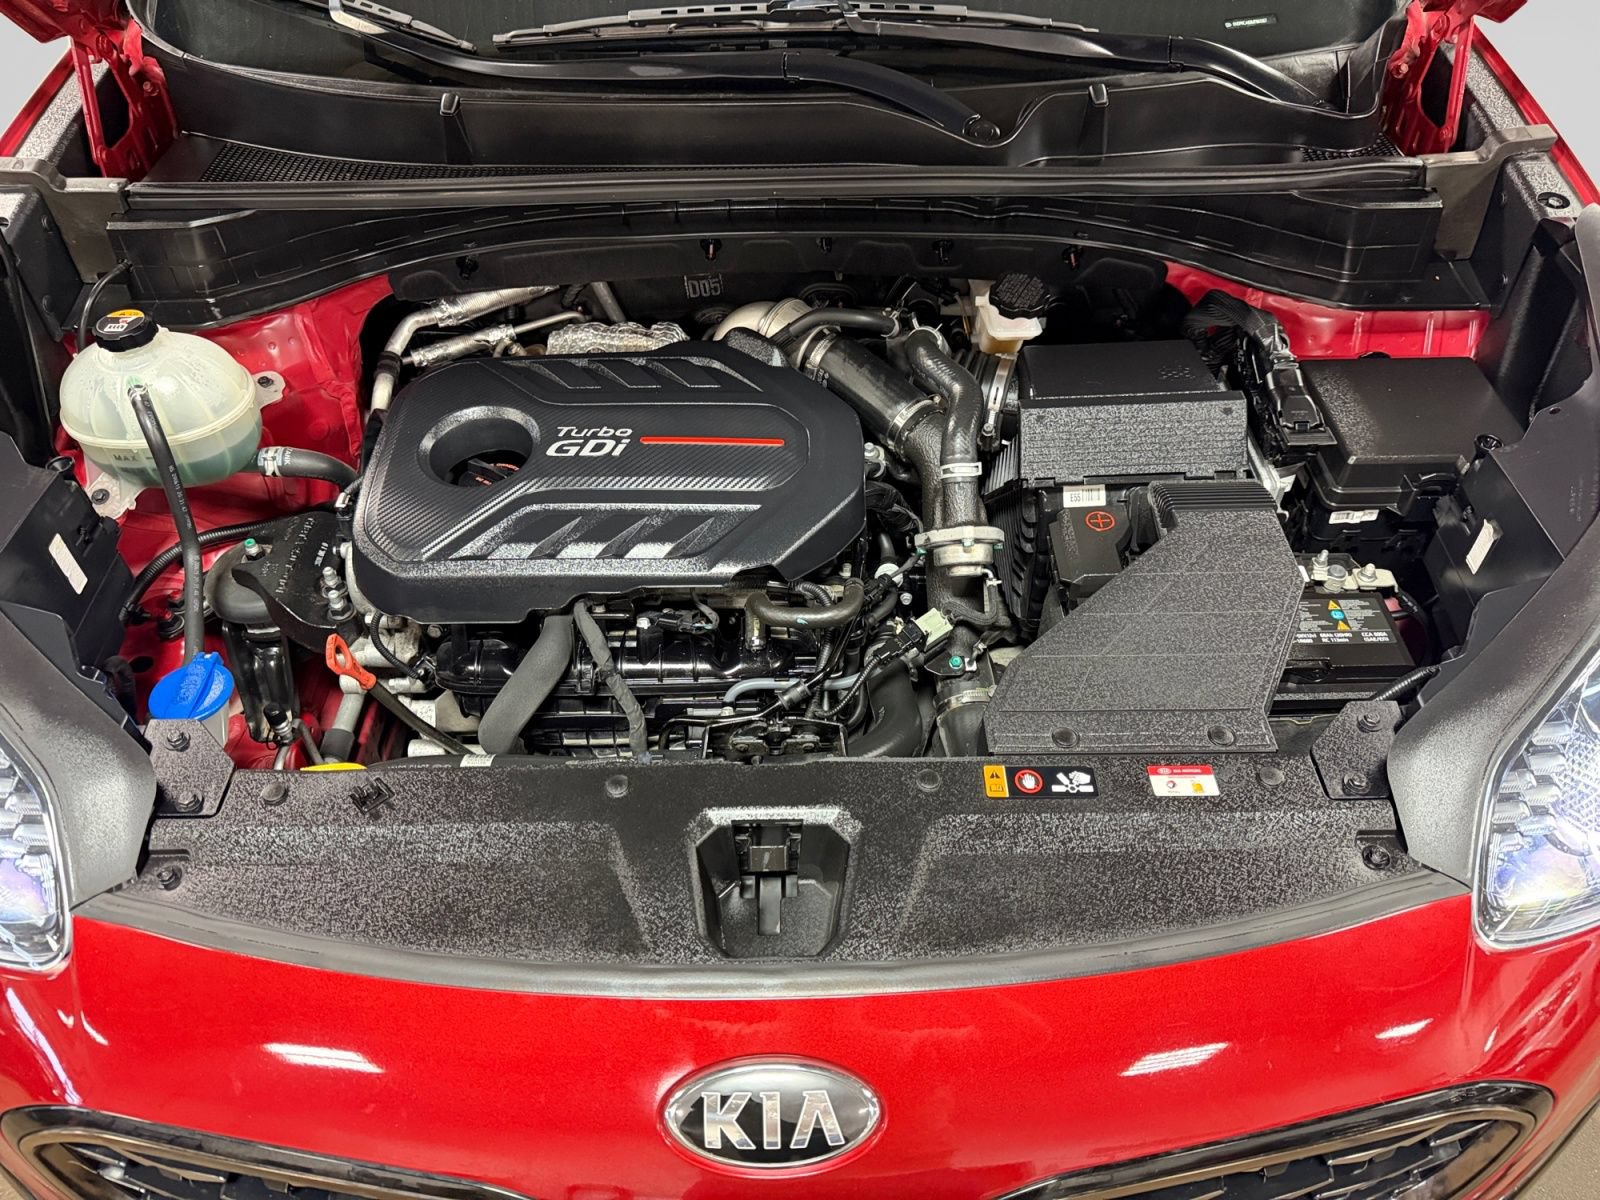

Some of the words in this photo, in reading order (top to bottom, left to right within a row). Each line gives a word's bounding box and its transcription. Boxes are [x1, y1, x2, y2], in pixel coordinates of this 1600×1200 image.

[557, 426, 633, 437] Turbo
[545, 438, 631, 456] GDi
[113, 454, 138, 462] MAX
[700, 1089, 846, 1150] KIA
